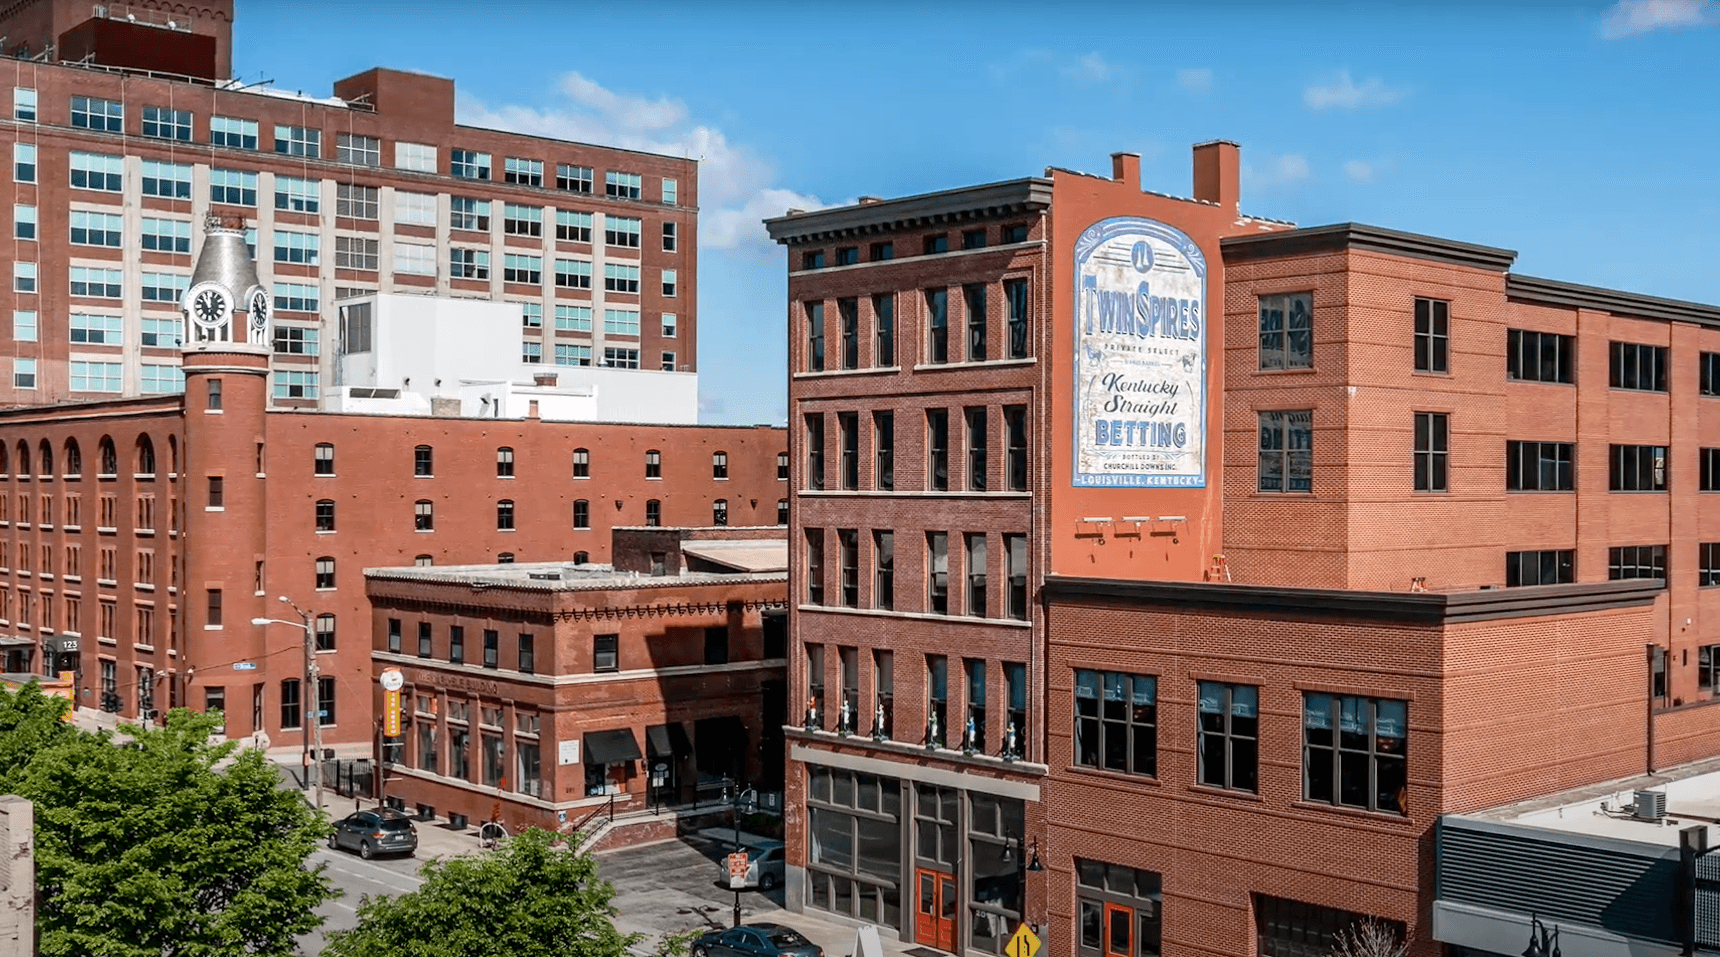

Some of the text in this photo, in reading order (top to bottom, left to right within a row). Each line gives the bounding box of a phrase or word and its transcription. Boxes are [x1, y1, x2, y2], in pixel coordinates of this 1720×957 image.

[1105, 343, 1179, 355] PRIVATE SELECT
[1102, 372, 1179, 399] Kentucky
[1103, 395, 1178, 418] Straight
[1095, 419, 1186, 448] BETTING
[1146, 475, 1199, 486] KENTUCKY
